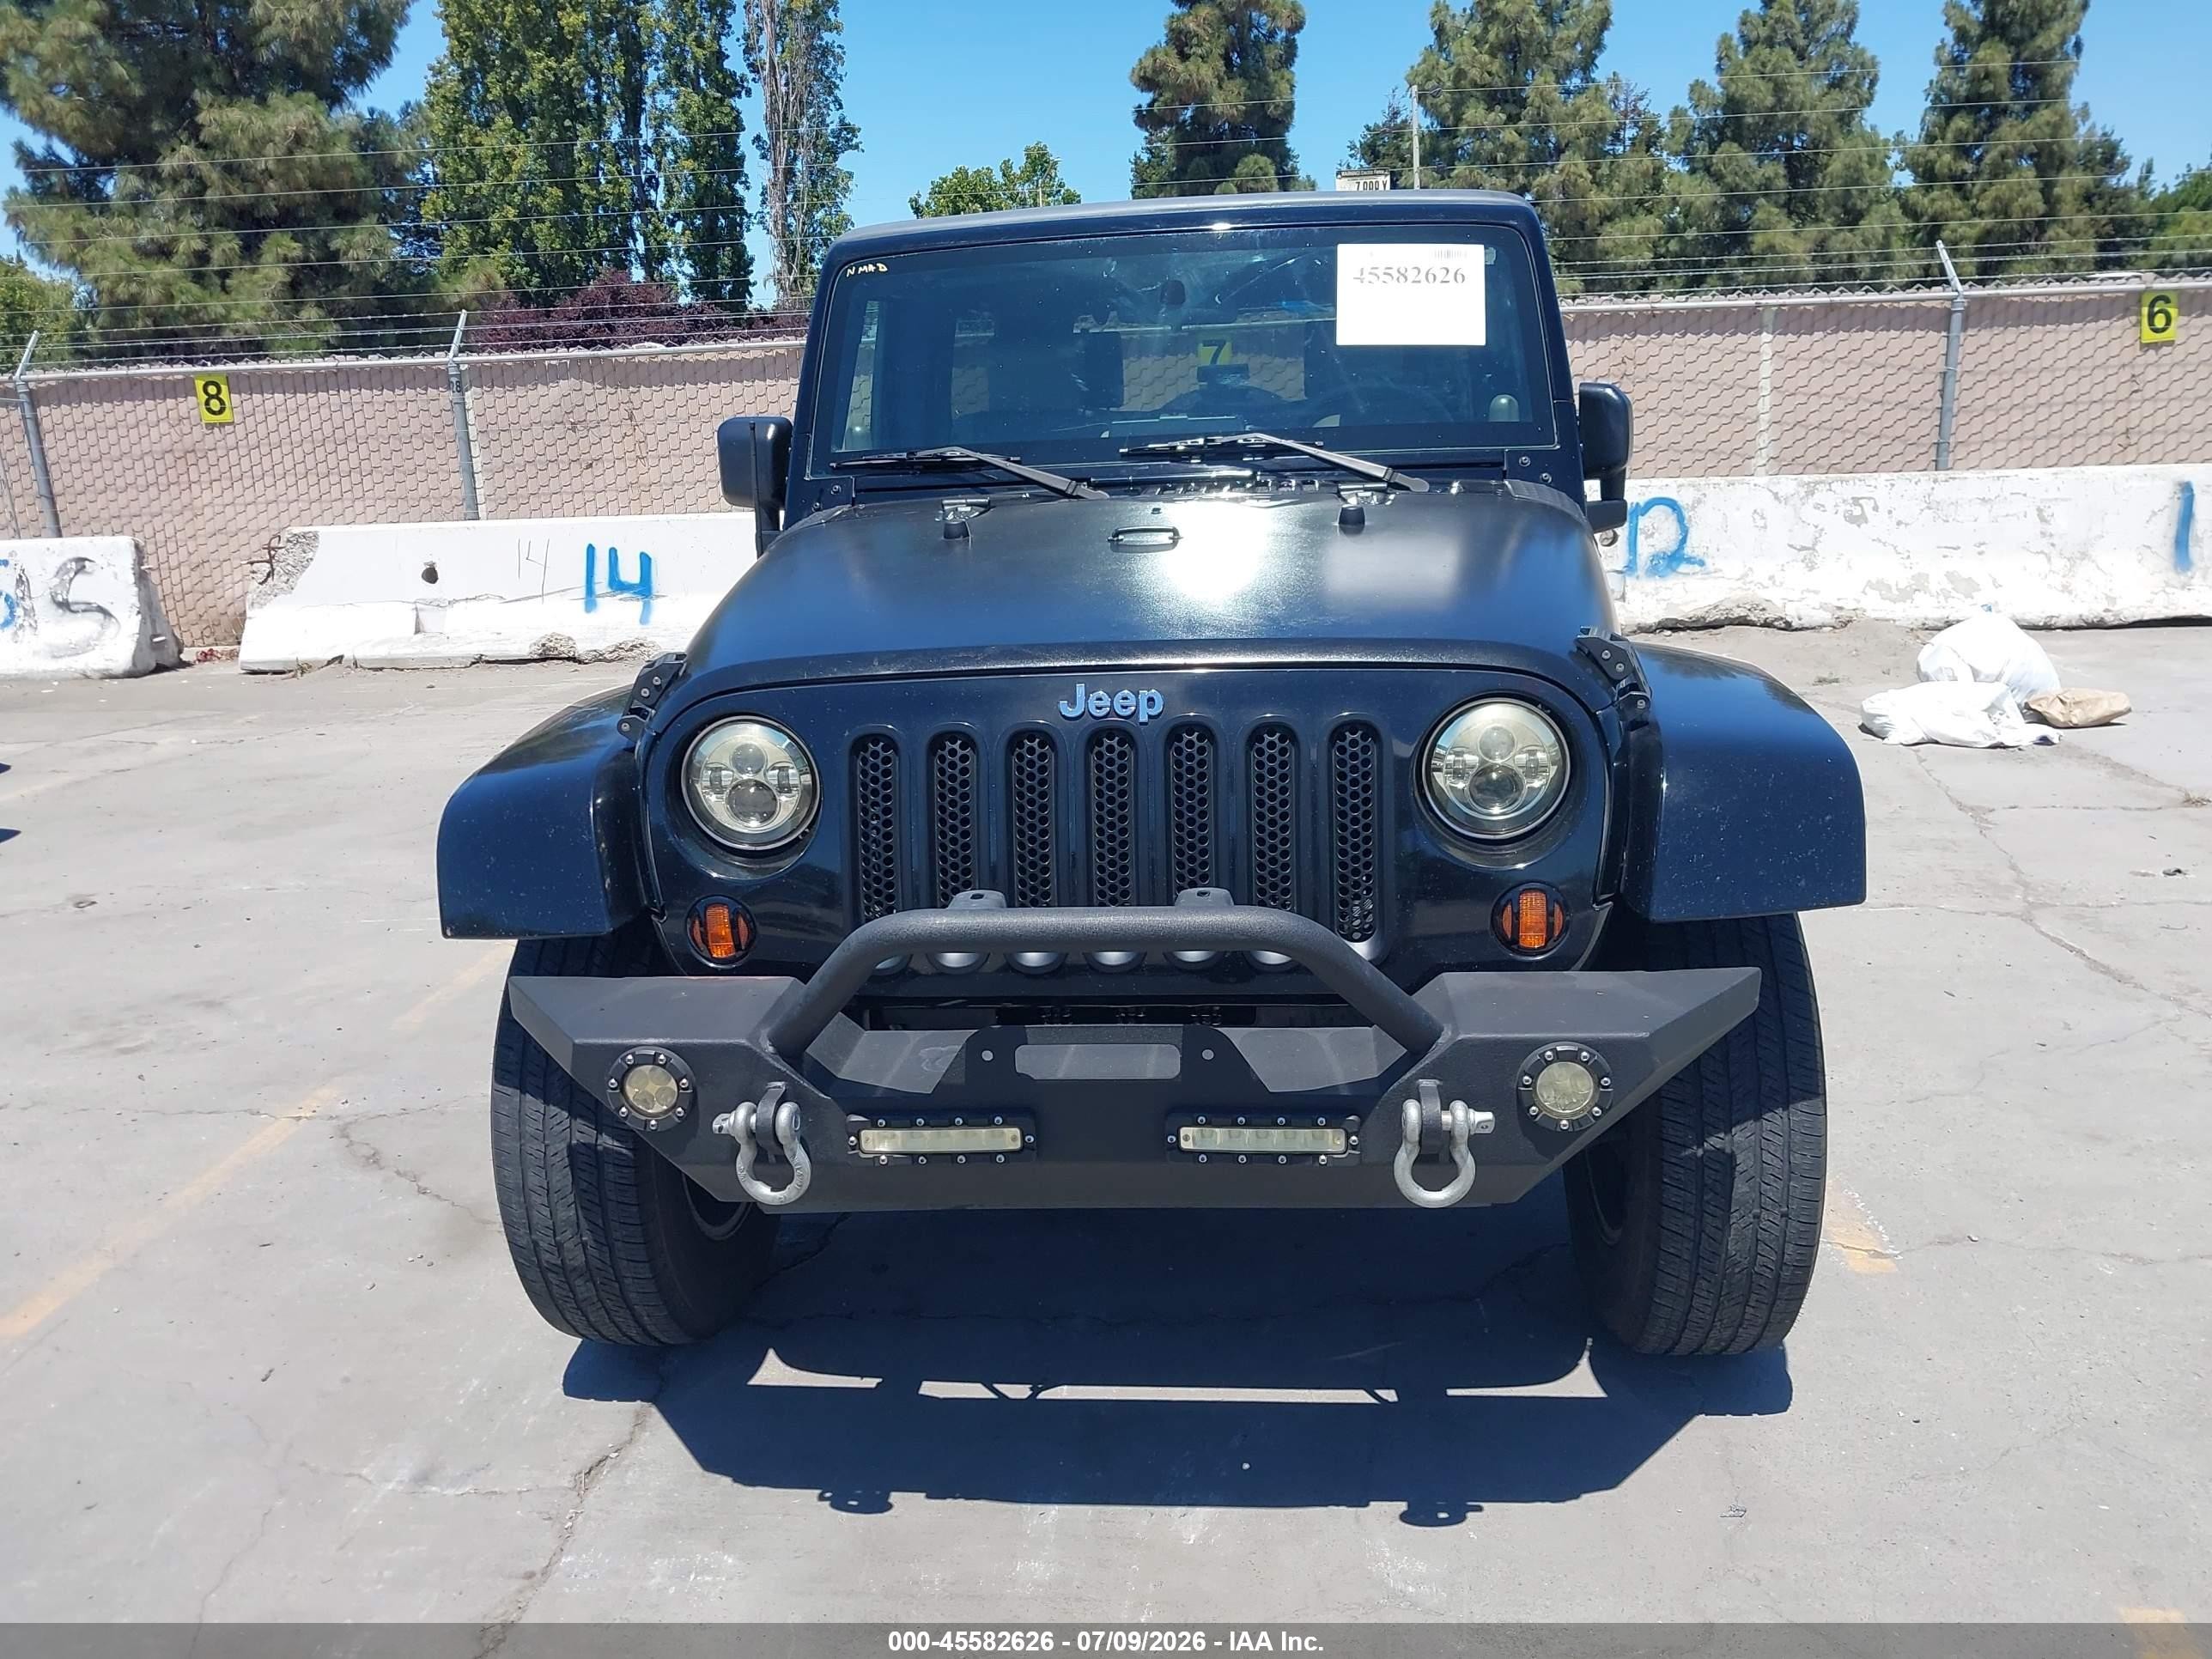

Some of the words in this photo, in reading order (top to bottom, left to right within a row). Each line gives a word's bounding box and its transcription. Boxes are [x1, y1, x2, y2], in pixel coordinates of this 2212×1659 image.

[1352, 266, 1467, 284] 45582626
[2148, 295, 2172, 334] 6
[1202, 339, 1226, 365] 7
[203, 380, 227, 416] 8
[584, 543, 653, 625] 14
[1059, 683, 1164, 724] Jeep
